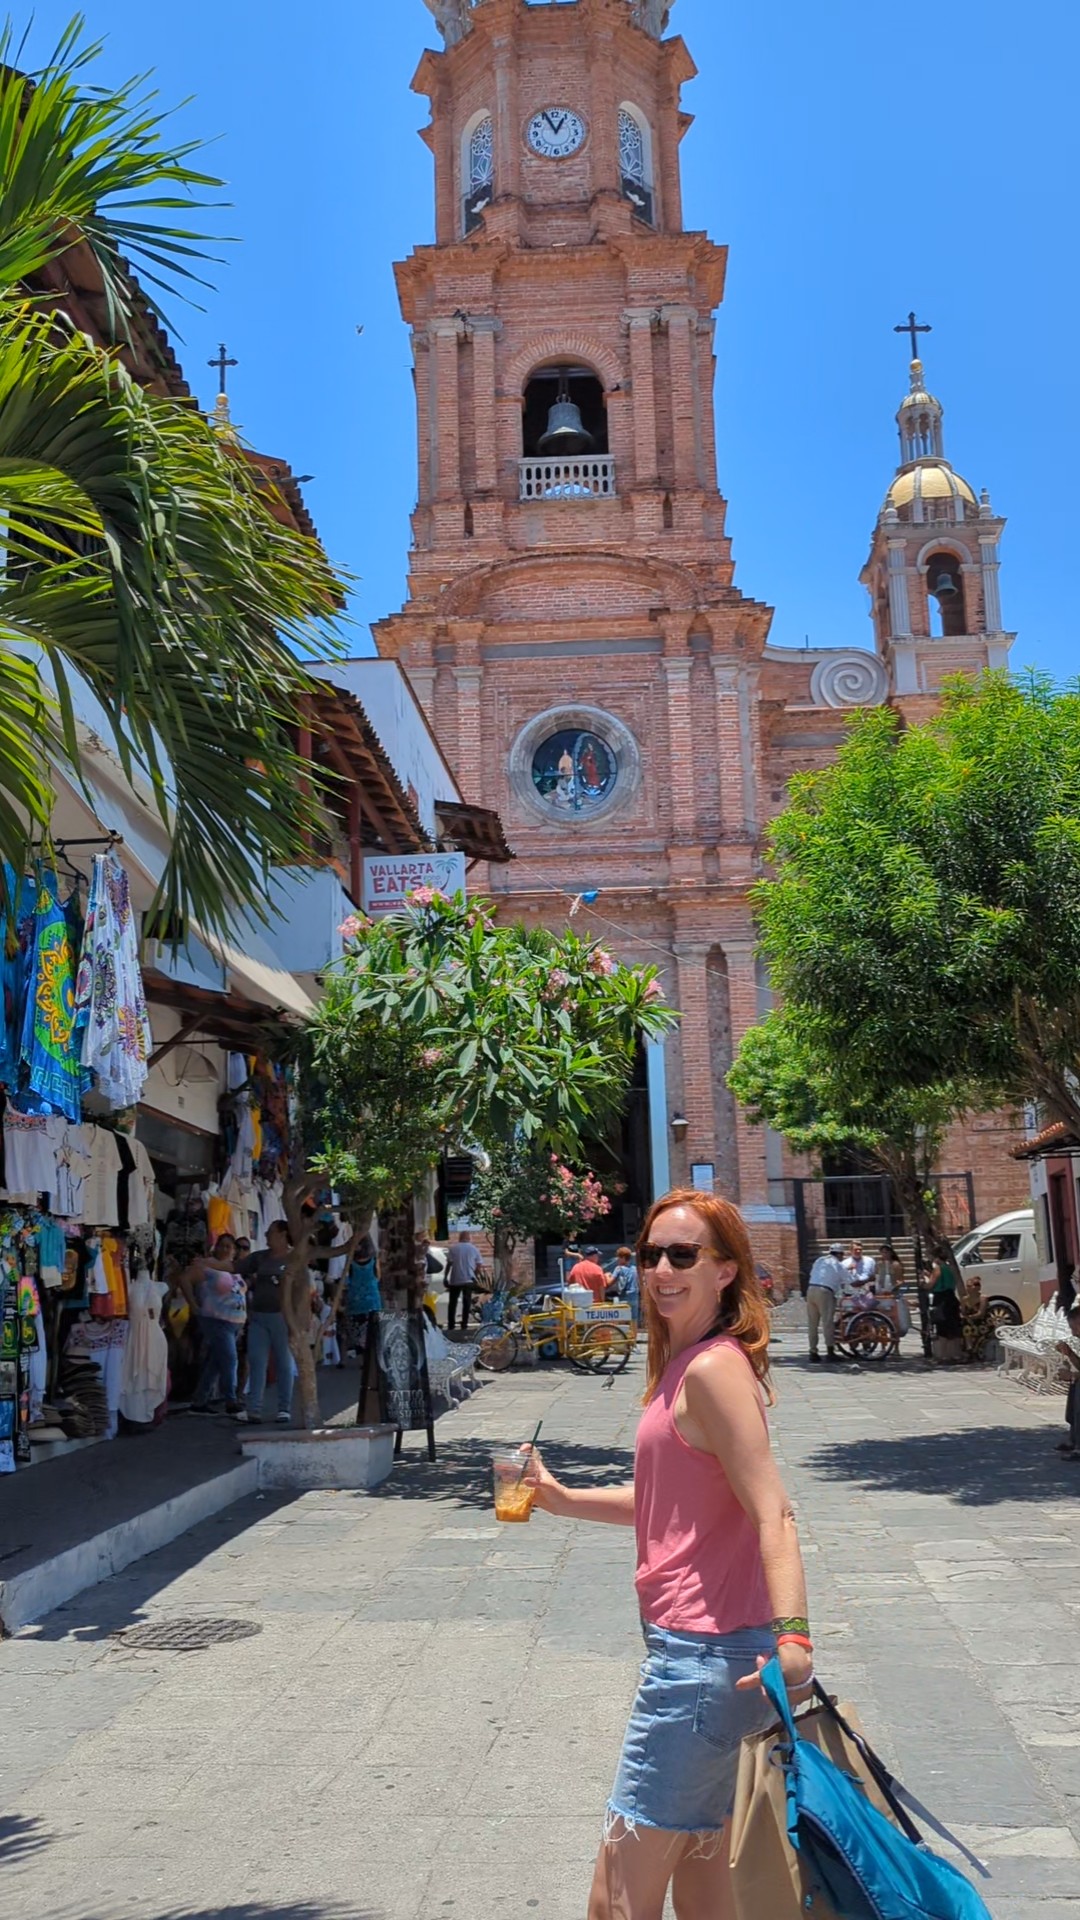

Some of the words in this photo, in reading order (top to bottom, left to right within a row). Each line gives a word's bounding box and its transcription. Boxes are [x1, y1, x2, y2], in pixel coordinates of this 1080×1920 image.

[369, 862, 434, 876] VALLARTA
[373, 876, 423, 892] EATS
[585, 1310, 620, 1320] TEJUINO
